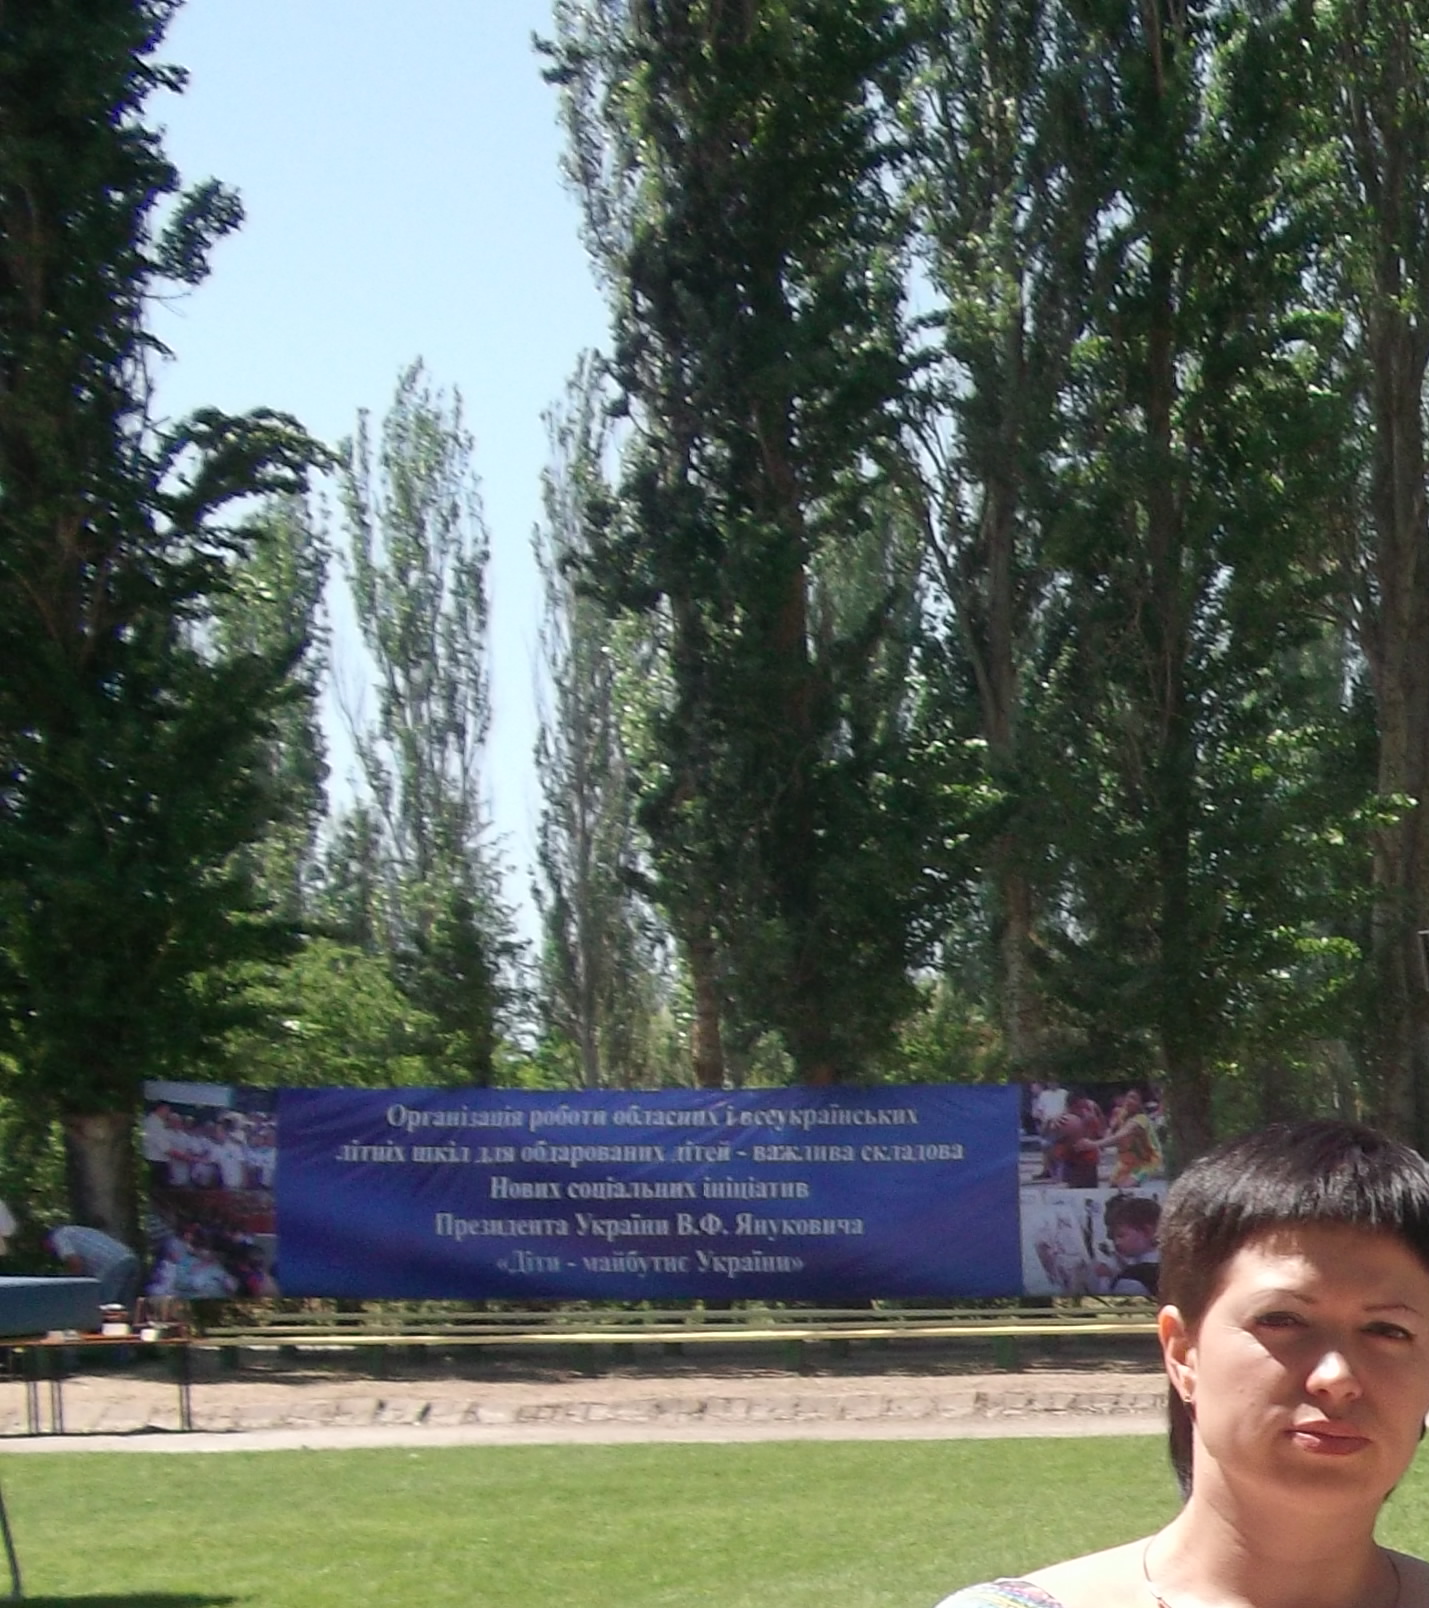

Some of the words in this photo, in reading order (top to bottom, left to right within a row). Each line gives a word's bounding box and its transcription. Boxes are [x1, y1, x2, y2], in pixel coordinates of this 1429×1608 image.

[574, 1212, 668, 1242] України
[676, 1212, 729, 1236] В.Ф.
[735, 1212, 864, 1241] Януковича
